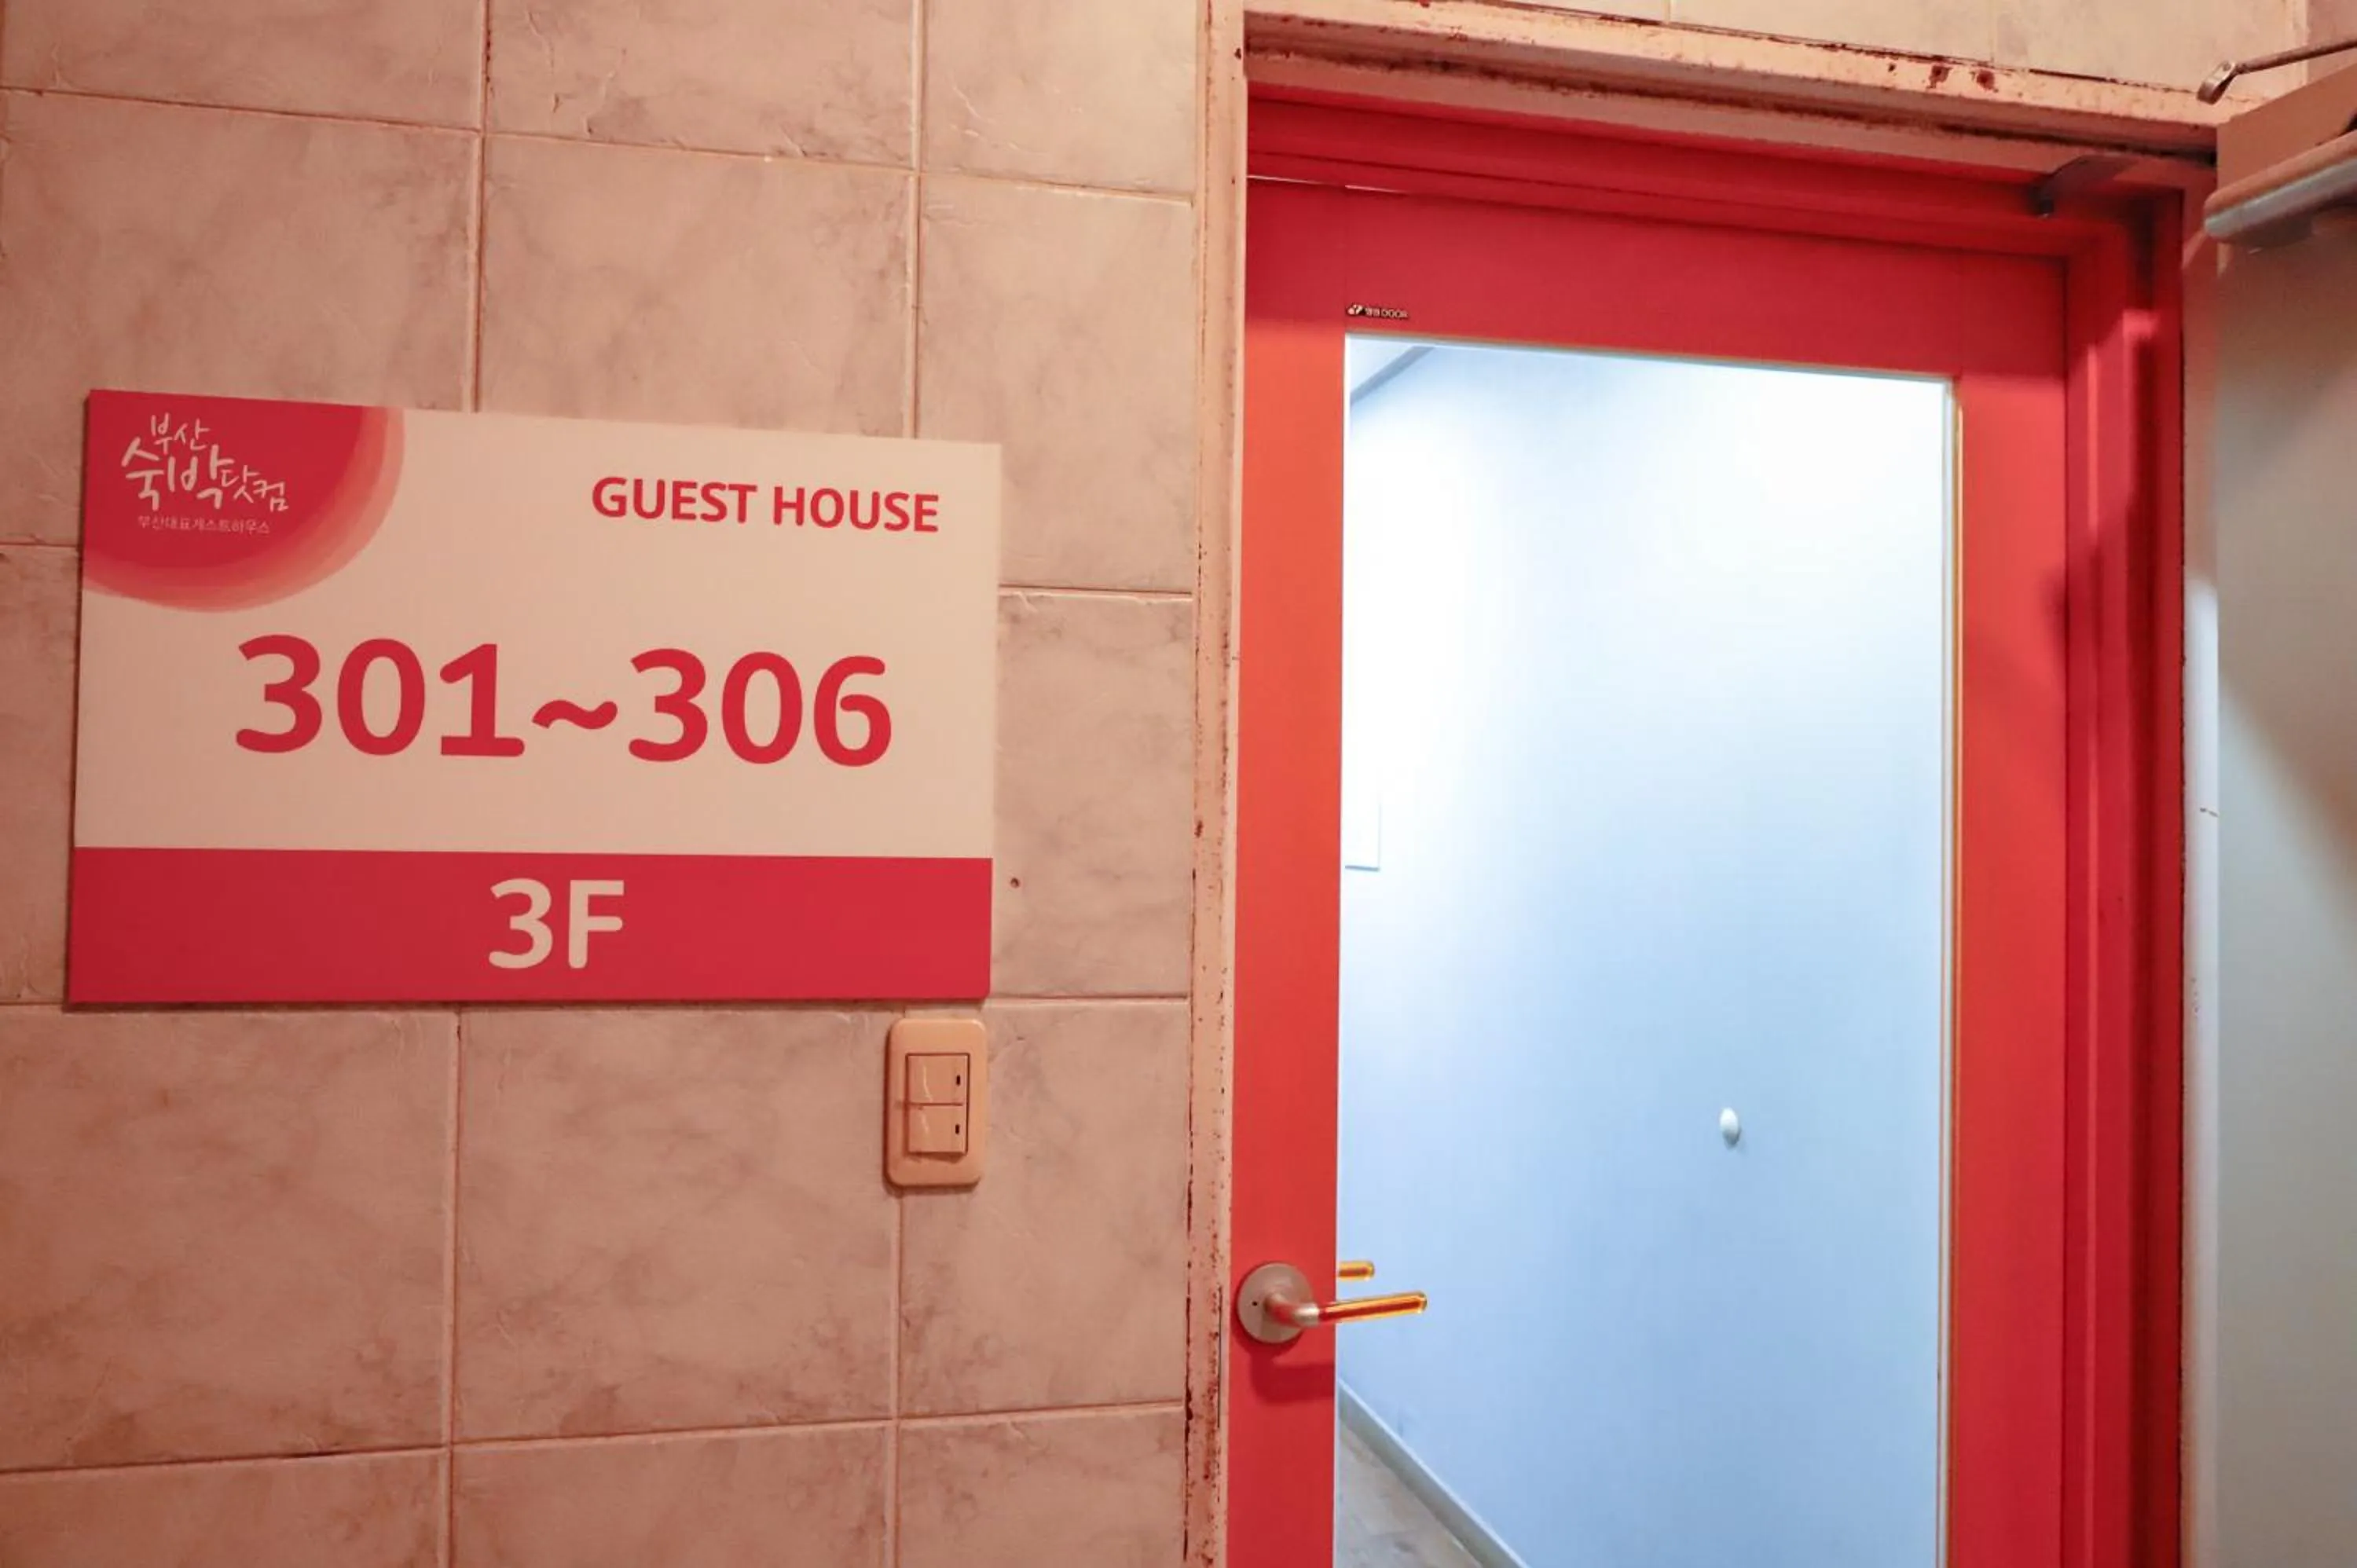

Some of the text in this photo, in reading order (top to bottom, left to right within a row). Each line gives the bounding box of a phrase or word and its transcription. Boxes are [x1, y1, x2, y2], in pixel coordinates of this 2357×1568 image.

[150, 412, 210, 453] 부산
[121, 437, 289, 512] 숙박닷컴
[592, 476, 939, 533] GUEST HOUSE
[235, 634, 892, 768] 301~306
[489, 877, 625, 969] 3F
